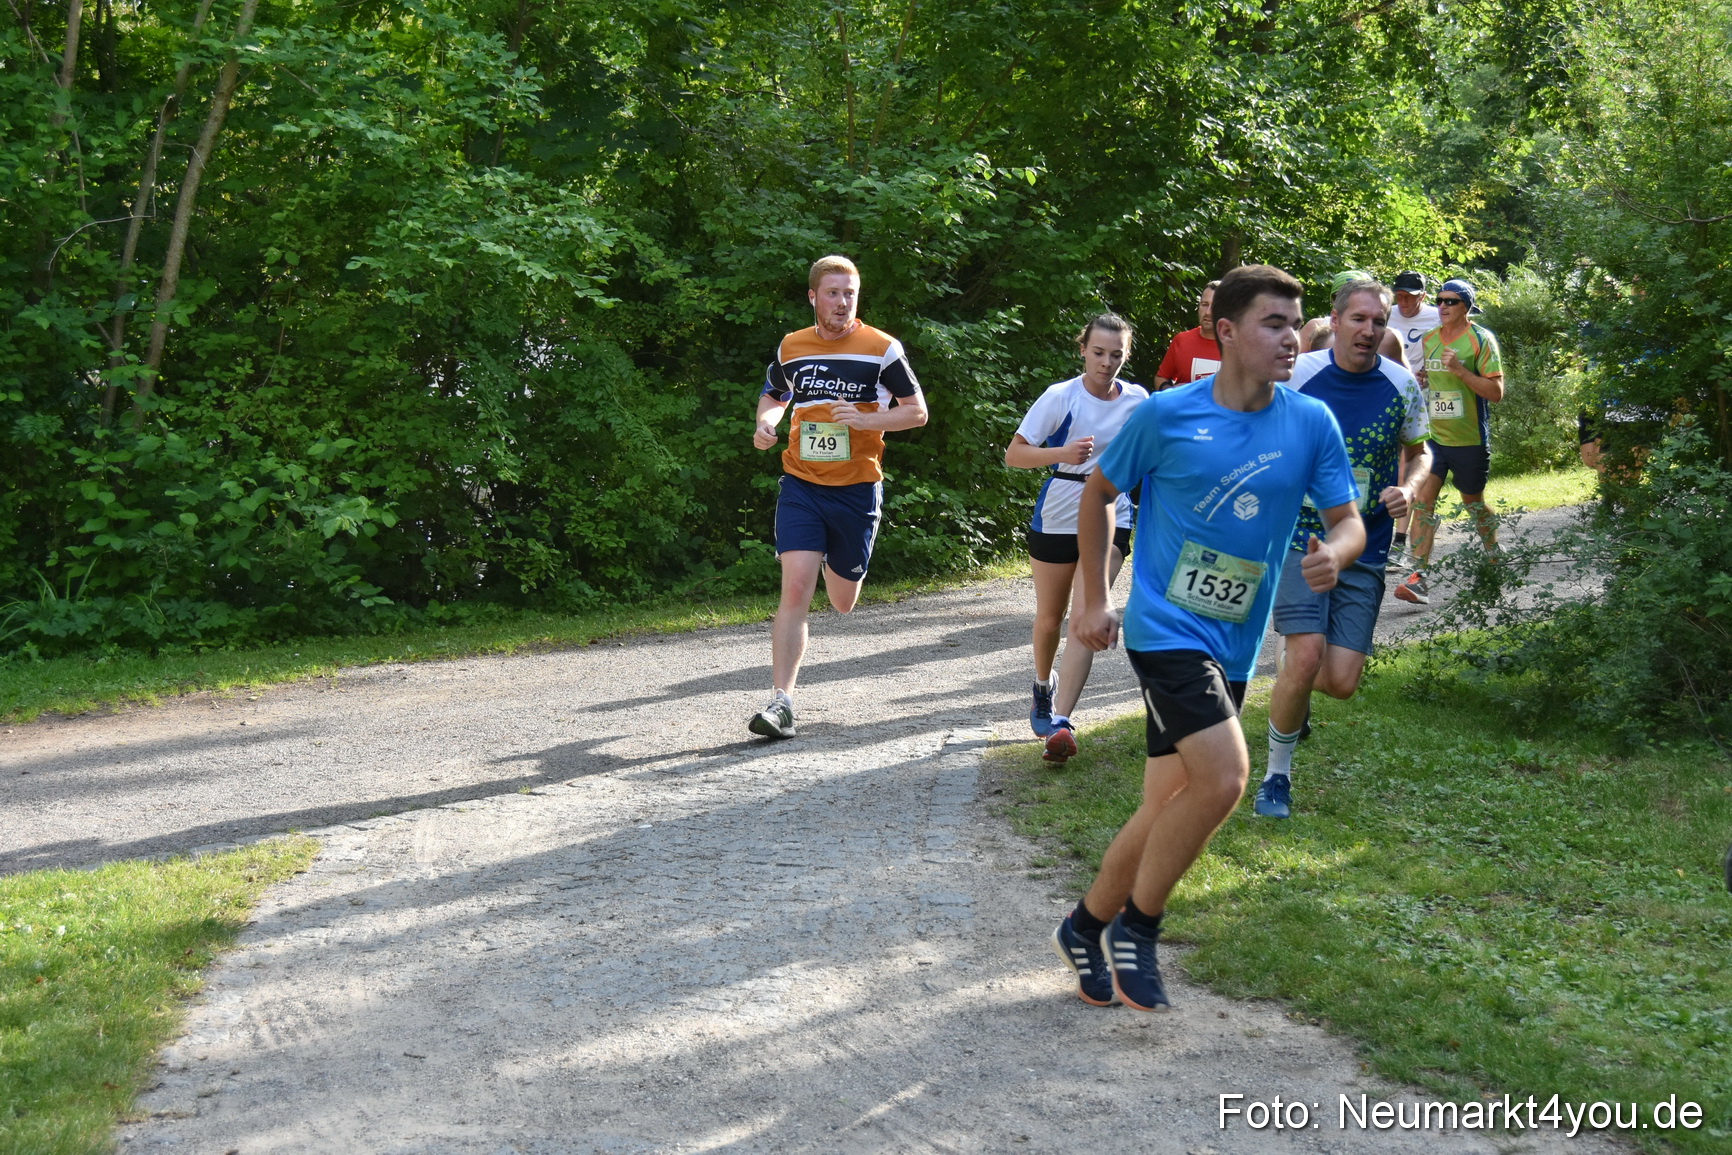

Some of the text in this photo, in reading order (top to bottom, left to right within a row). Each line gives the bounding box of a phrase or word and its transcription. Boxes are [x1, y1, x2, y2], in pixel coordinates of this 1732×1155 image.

[801, 376, 867, 392] Fischer
[1435, 401, 1454, 411] 304
[809, 436, 837, 450] 749
[1192, 450, 1282, 513] Team Schick Bau
[1186, 569, 1247, 605] 1532
